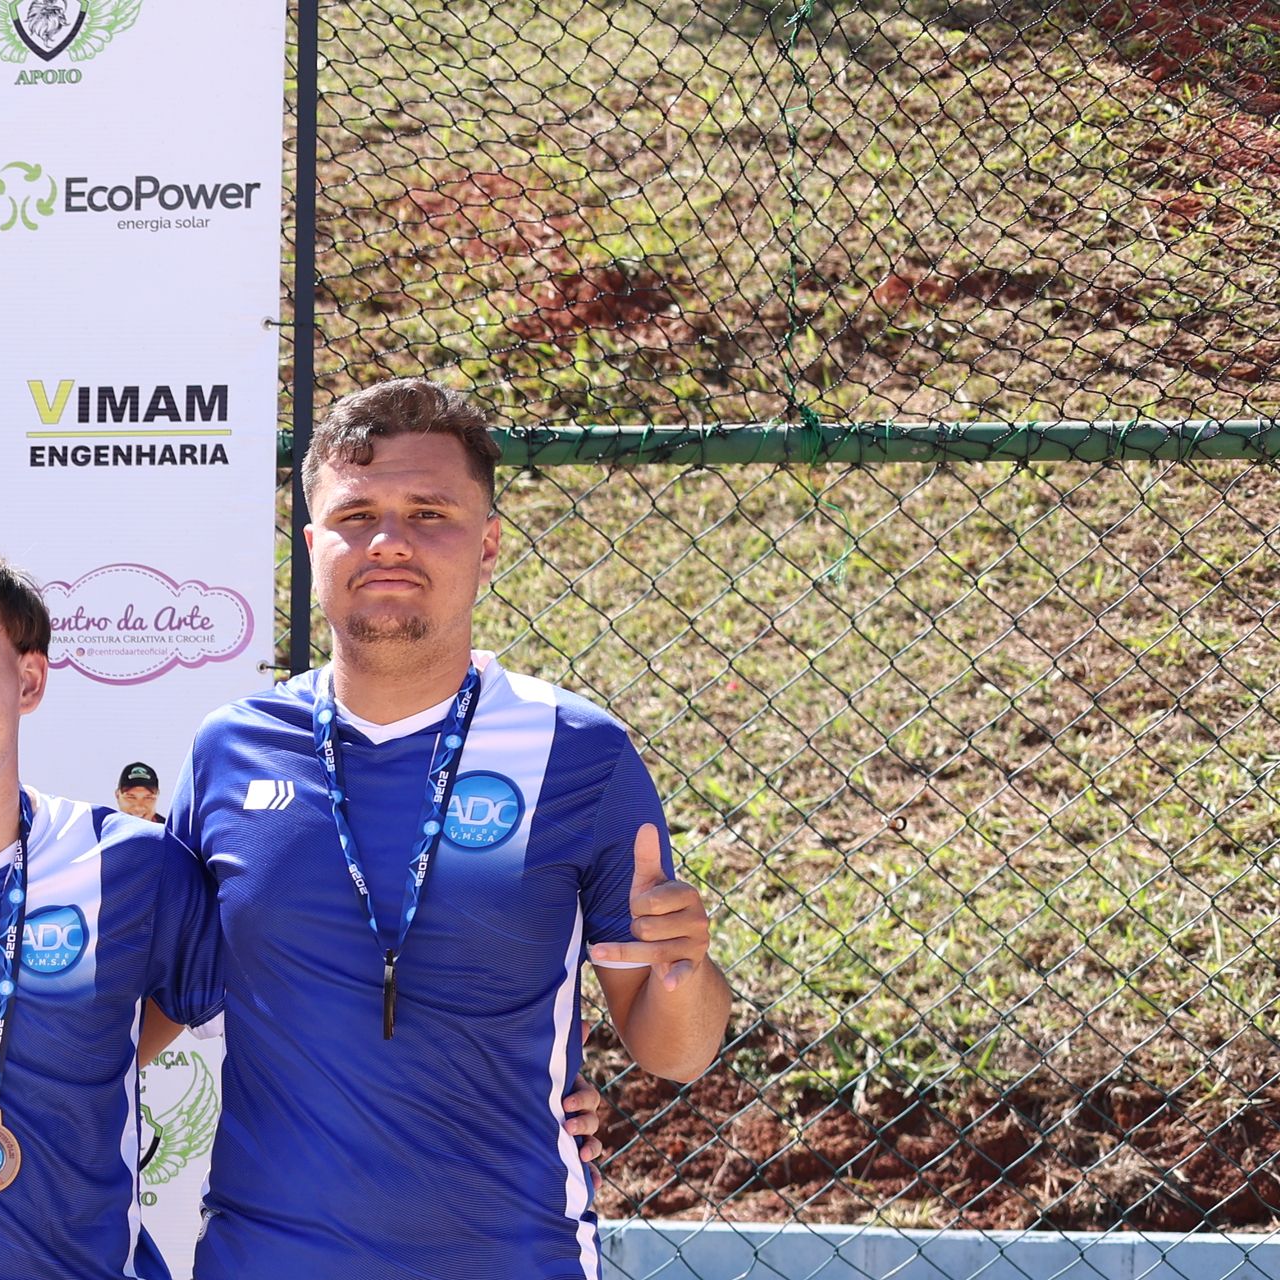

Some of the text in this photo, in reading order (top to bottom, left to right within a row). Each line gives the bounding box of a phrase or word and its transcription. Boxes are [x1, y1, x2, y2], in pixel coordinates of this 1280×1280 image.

[14, 69, 82, 85] APOIO
[65, 175, 261, 213] EcoPower
[117, 216, 210, 232] energia solar
[27, 379, 228, 424] VIMAM
[30, 444, 229, 467] ENGENHARIA
[50, 604, 214, 632] entro da Arte
[52, 635, 76, 643] PARA
[87, 648, 168, 656] @centrodaarteoficial
[456, 690, 473, 719] 2026
[434, 770, 449, 803] 2026
[447, 795, 516, 828] ADC
[349, 864, 368, 895] 2026
[415, 853, 429, 887] 2026
[5, 925, 17, 959] 2026
[22, 924, 82, 950] ADC
